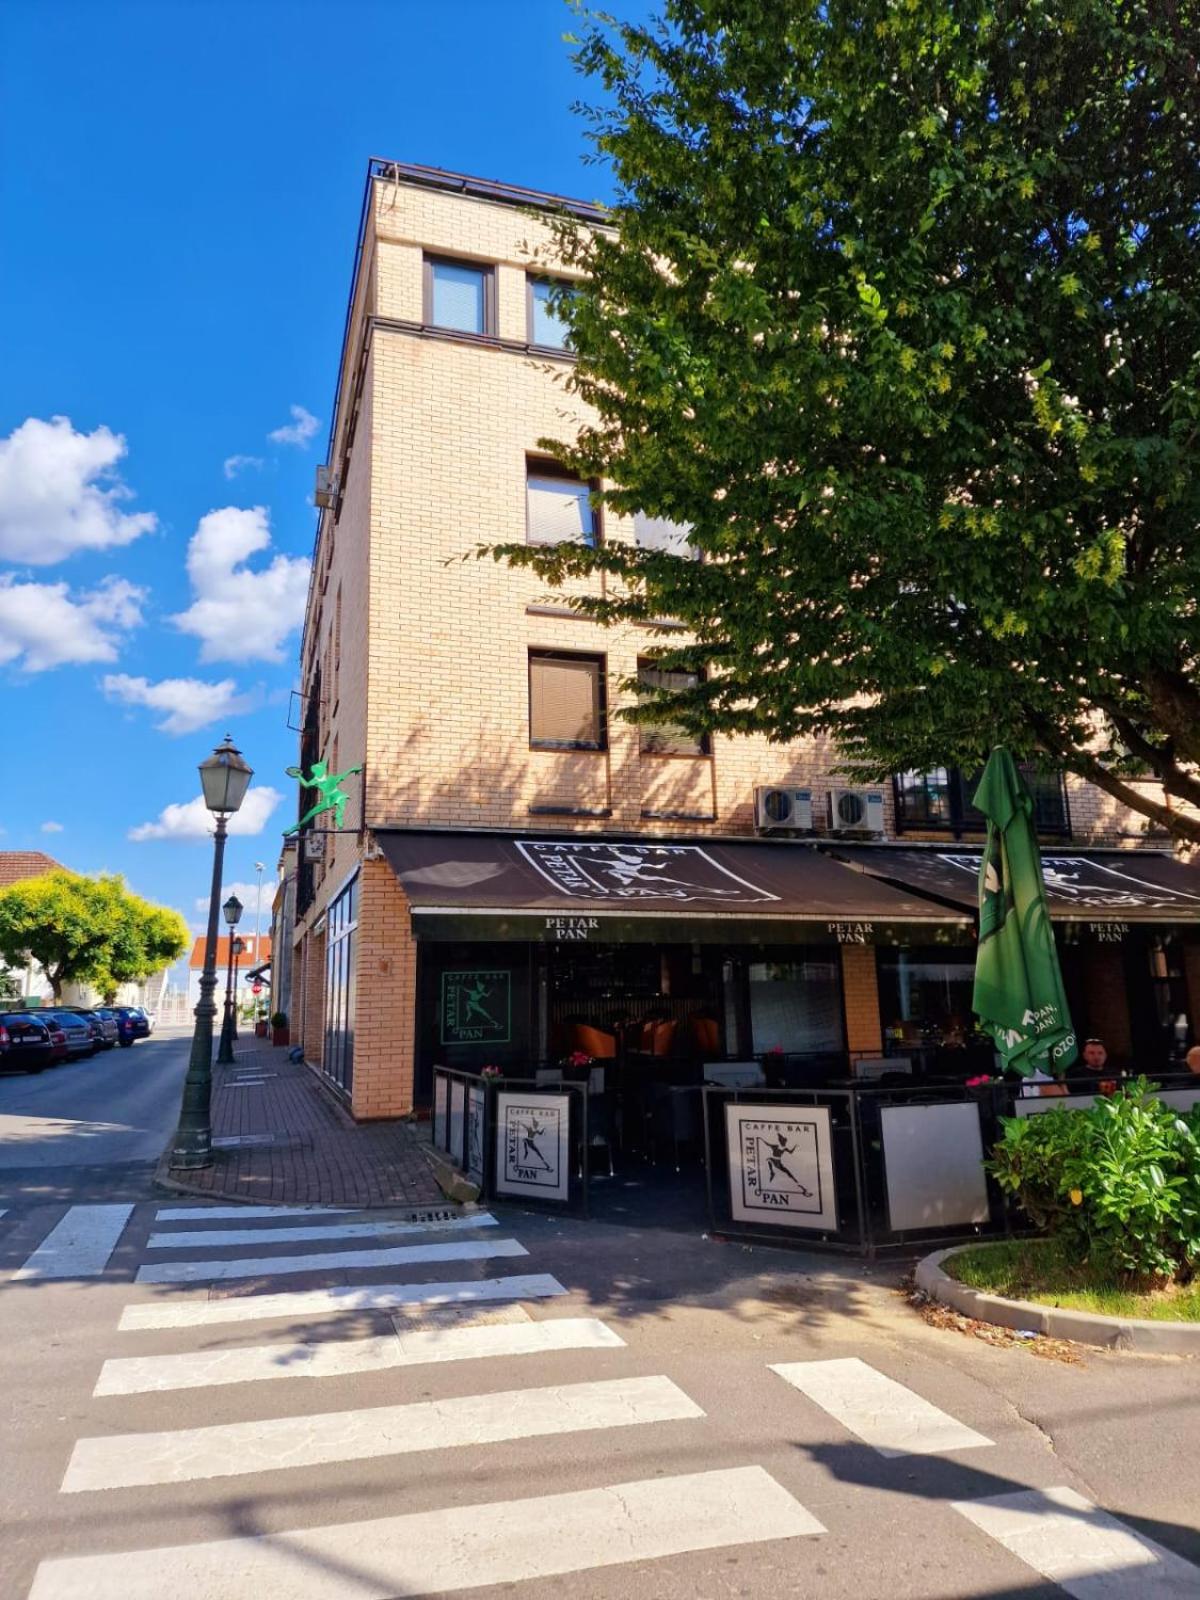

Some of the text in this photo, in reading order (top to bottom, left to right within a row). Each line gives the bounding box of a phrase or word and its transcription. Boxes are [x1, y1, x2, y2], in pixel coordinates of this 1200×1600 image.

[545, 917, 599, 929] PETAR
[828, 922, 874, 933] PETAR
[1090, 923, 1130, 933] PETAR
[556, 928, 588, 939] PAN
[837, 933, 865, 944] PAN
[1098, 933, 1122, 942] PAN
[447, 986, 456, 1027] PETAR
[459, 1028, 483, 1040] PAN
[745, 1123, 810, 1133] CAFFE BAR
[509, 1120, 517, 1164] PETAR
[745, 1137, 757, 1187] PETAR
[517, 1169, 538, 1180] PAN
[762, 1193, 790, 1206] PAN
